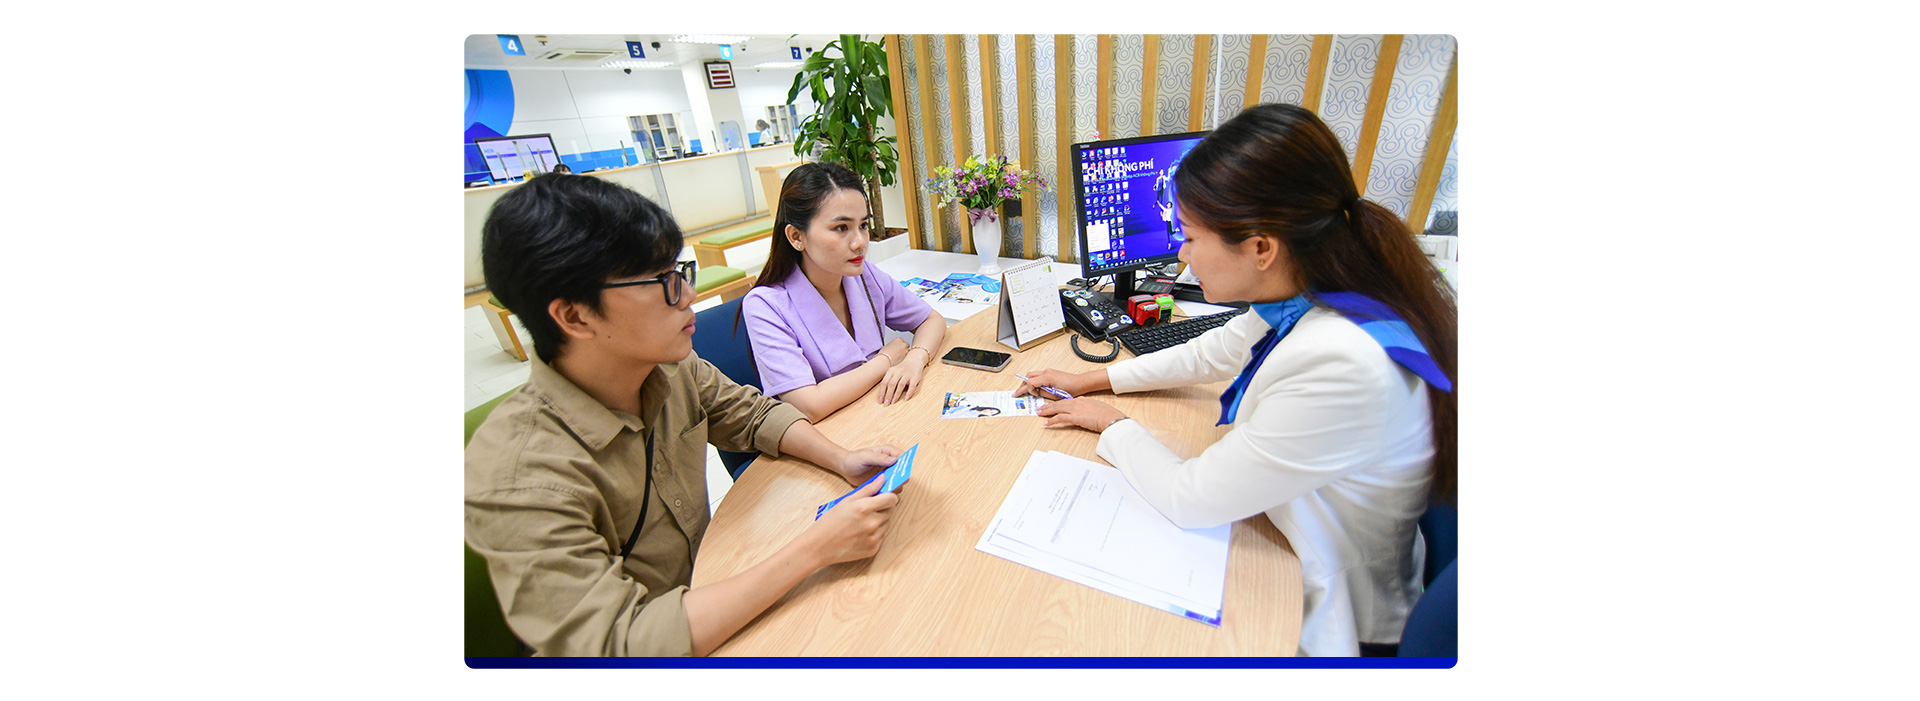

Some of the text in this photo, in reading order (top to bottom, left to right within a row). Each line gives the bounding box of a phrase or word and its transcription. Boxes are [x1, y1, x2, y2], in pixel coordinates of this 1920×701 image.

[508, 39, 518, 52] 4
[632, 45, 641, 56] 5
[723, 47, 731, 58] 6
[793, 50, 799, 58] 7
[1138, 158, 1154, 171] PHÍ
